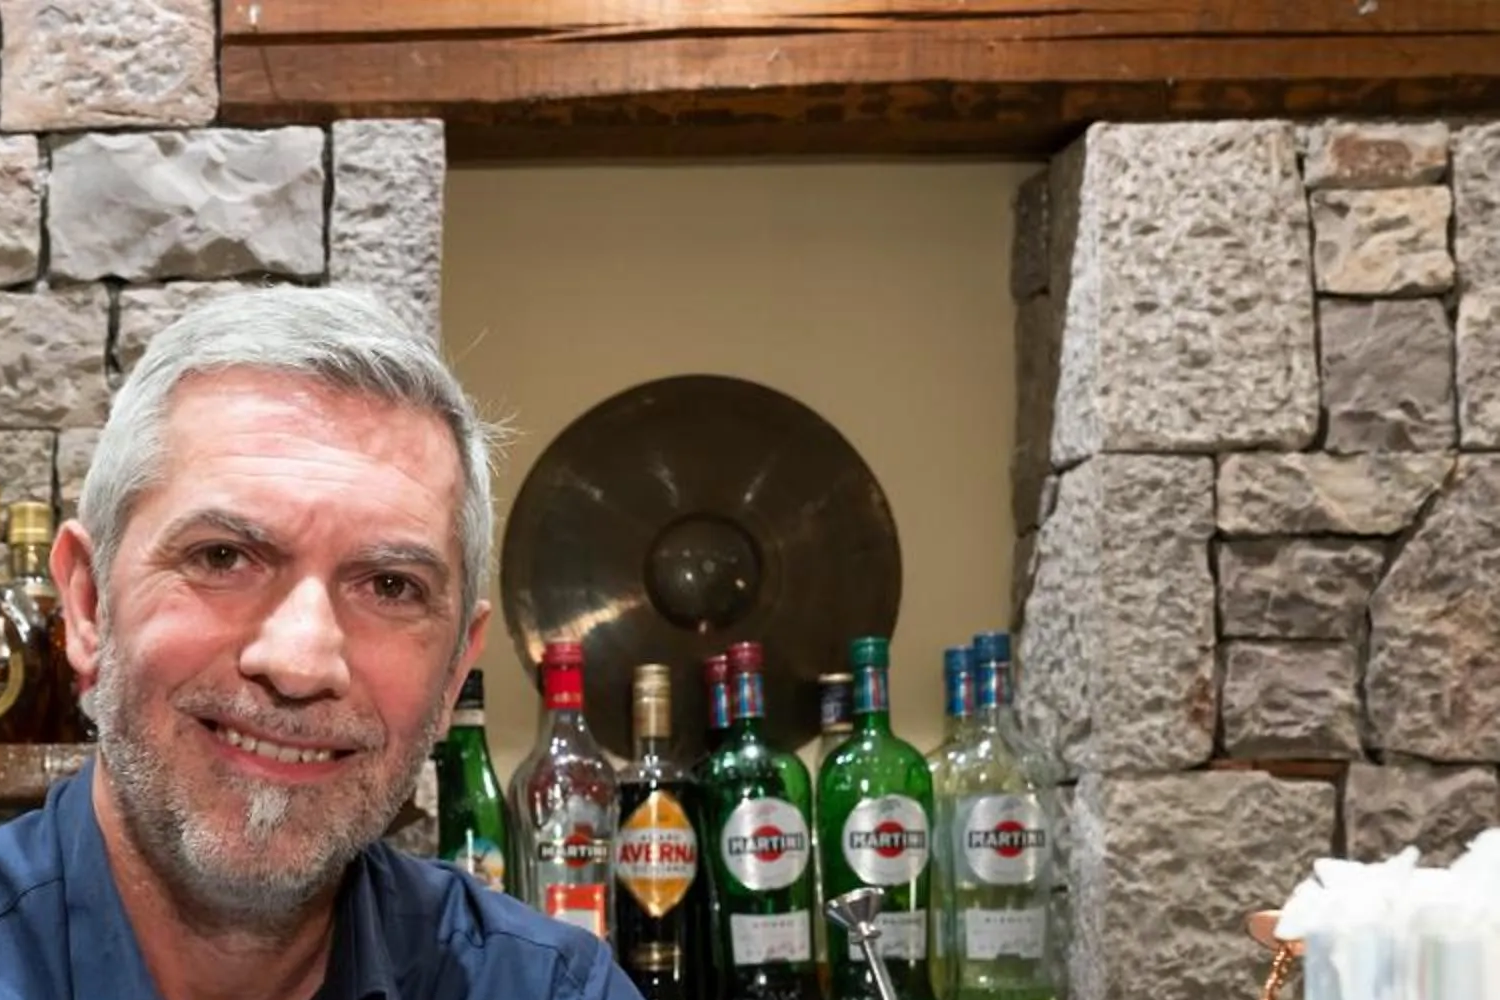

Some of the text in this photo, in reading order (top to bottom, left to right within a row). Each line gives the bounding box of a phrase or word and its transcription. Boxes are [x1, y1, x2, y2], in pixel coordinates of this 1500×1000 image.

[729, 832, 804, 856] MARTINI
[850, 831, 926, 849] MARTINI
[968, 830, 1046, 848] MARTINI
[540, 843, 607, 861] MARTINI
[619, 842, 695, 865] AVERNA
